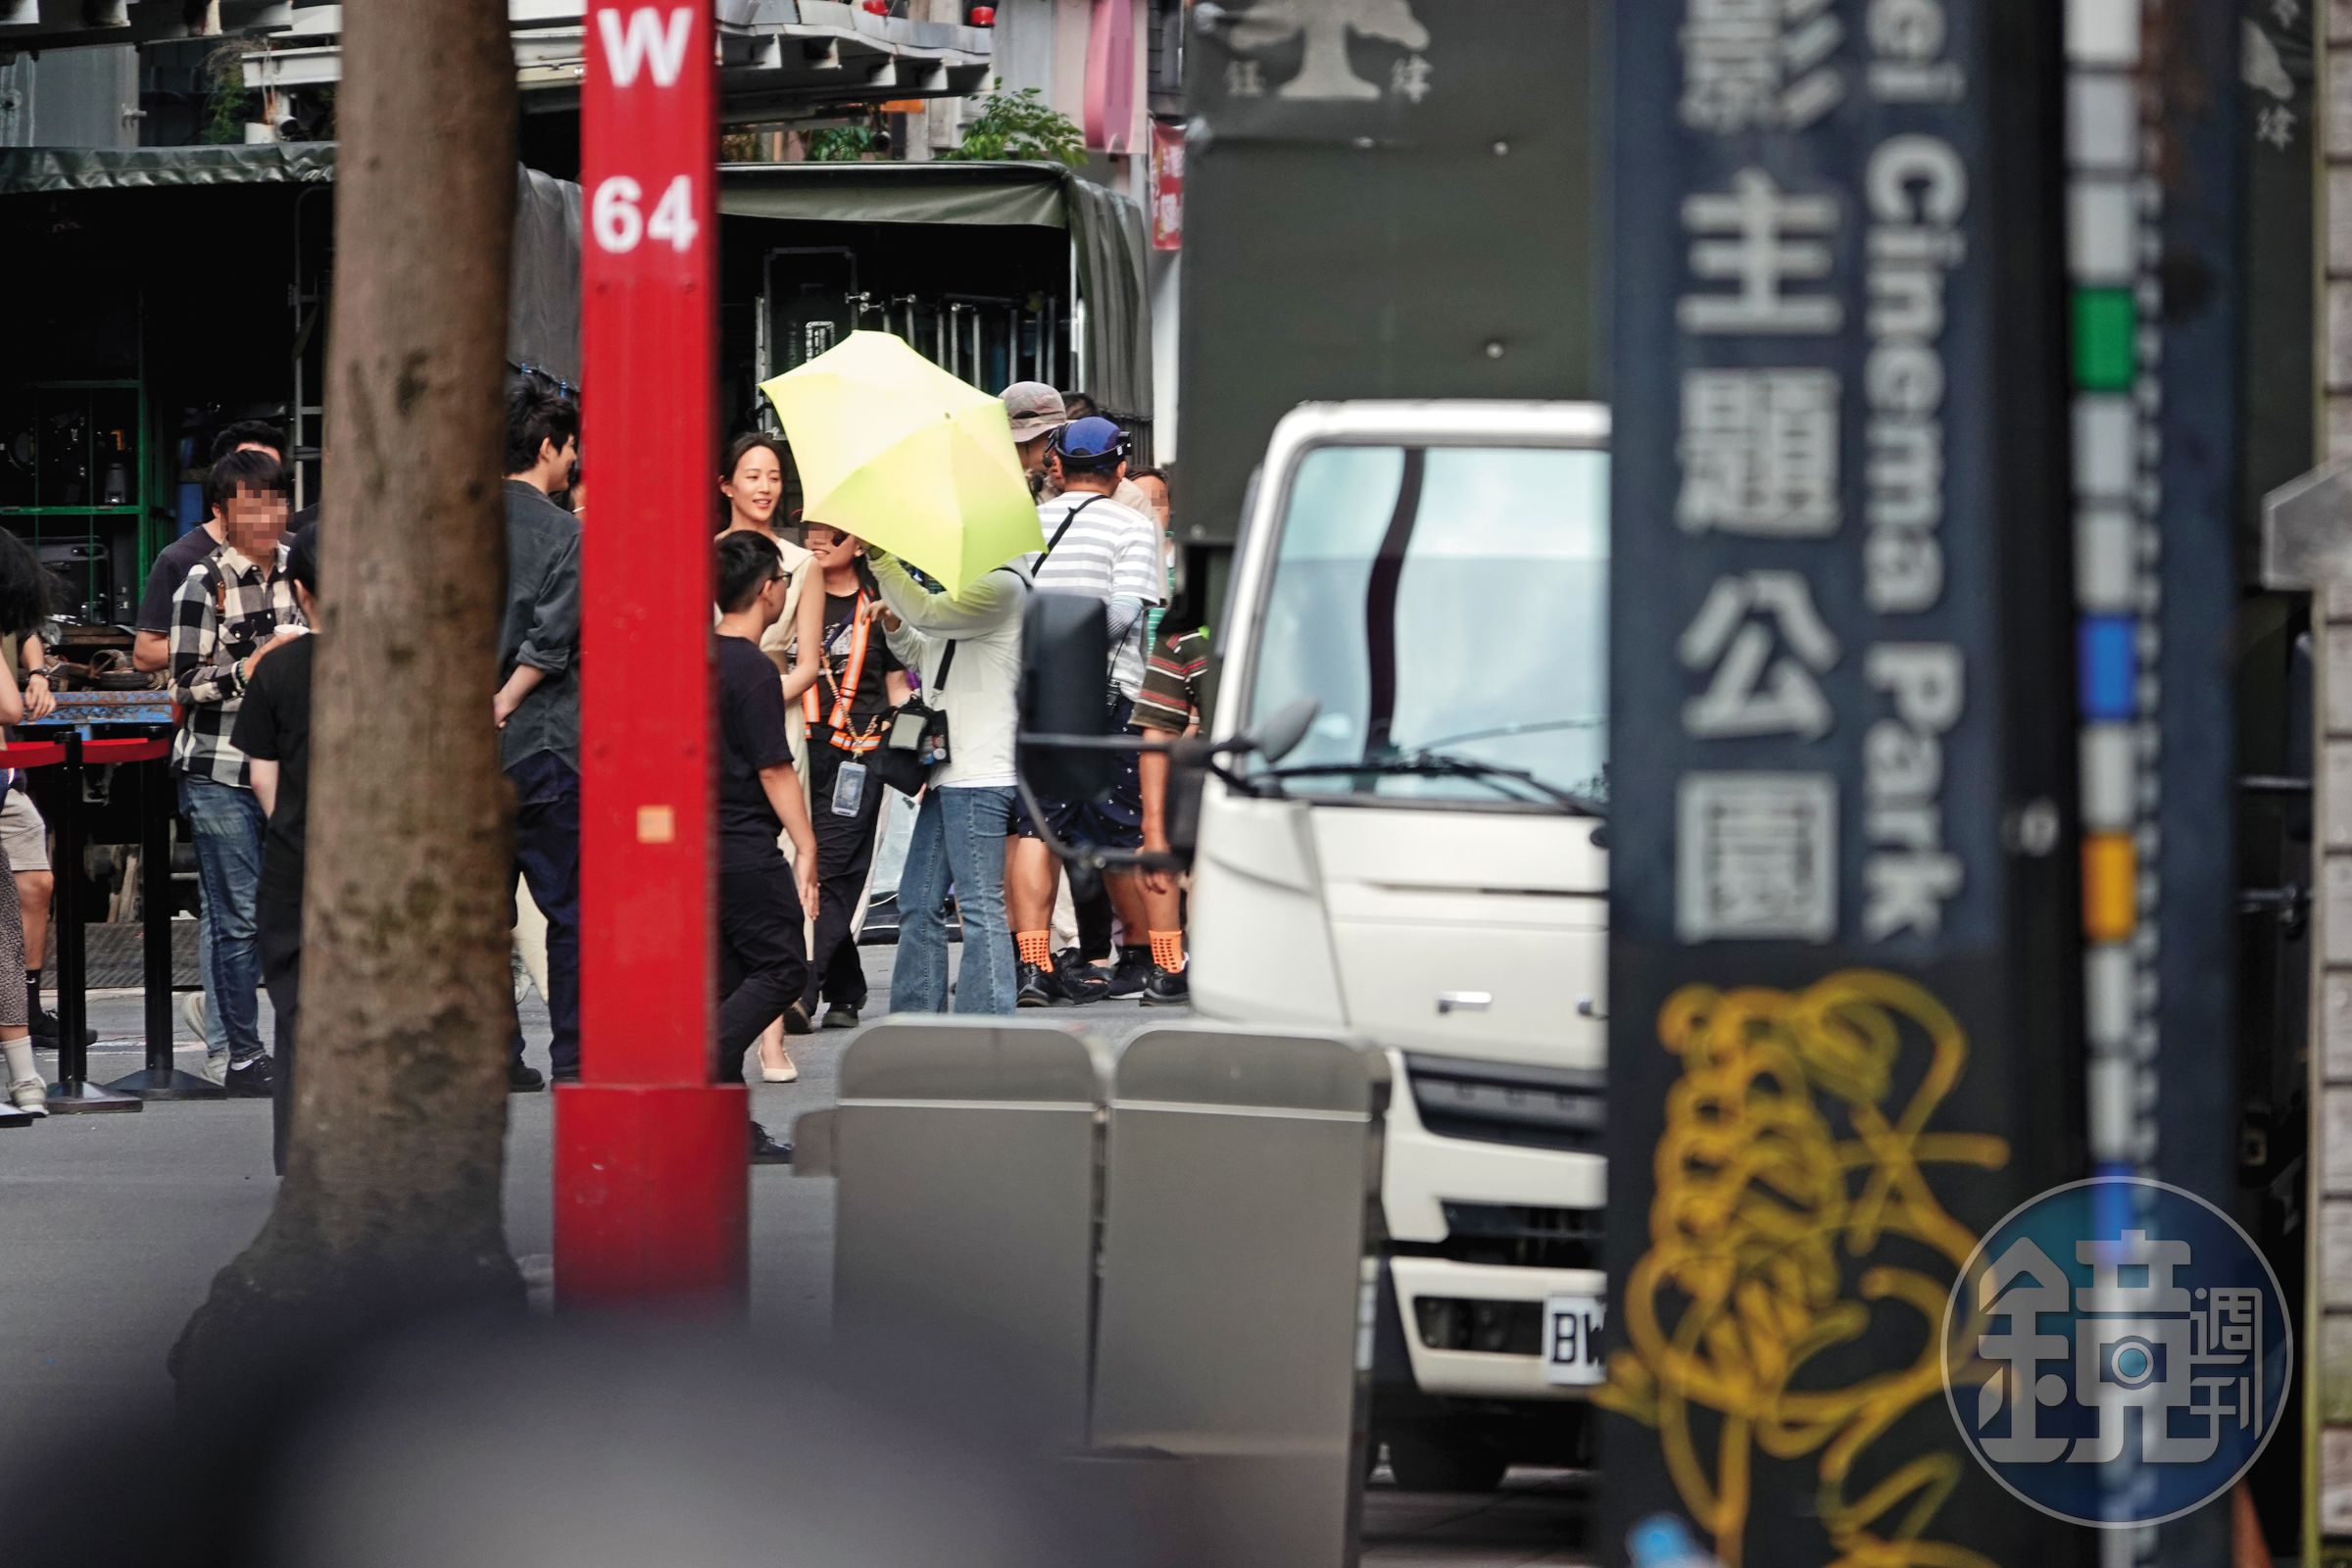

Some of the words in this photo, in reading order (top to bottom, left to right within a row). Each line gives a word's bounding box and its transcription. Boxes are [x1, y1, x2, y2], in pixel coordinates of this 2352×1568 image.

[596, 6, 695, 88] W
[592, 173, 699, 254] 64
[1674, 0, 1844, 943] 影主題公園
[1865, 133, 1968, 615] Cinema
[1864, 641, 1965, 943] Park
